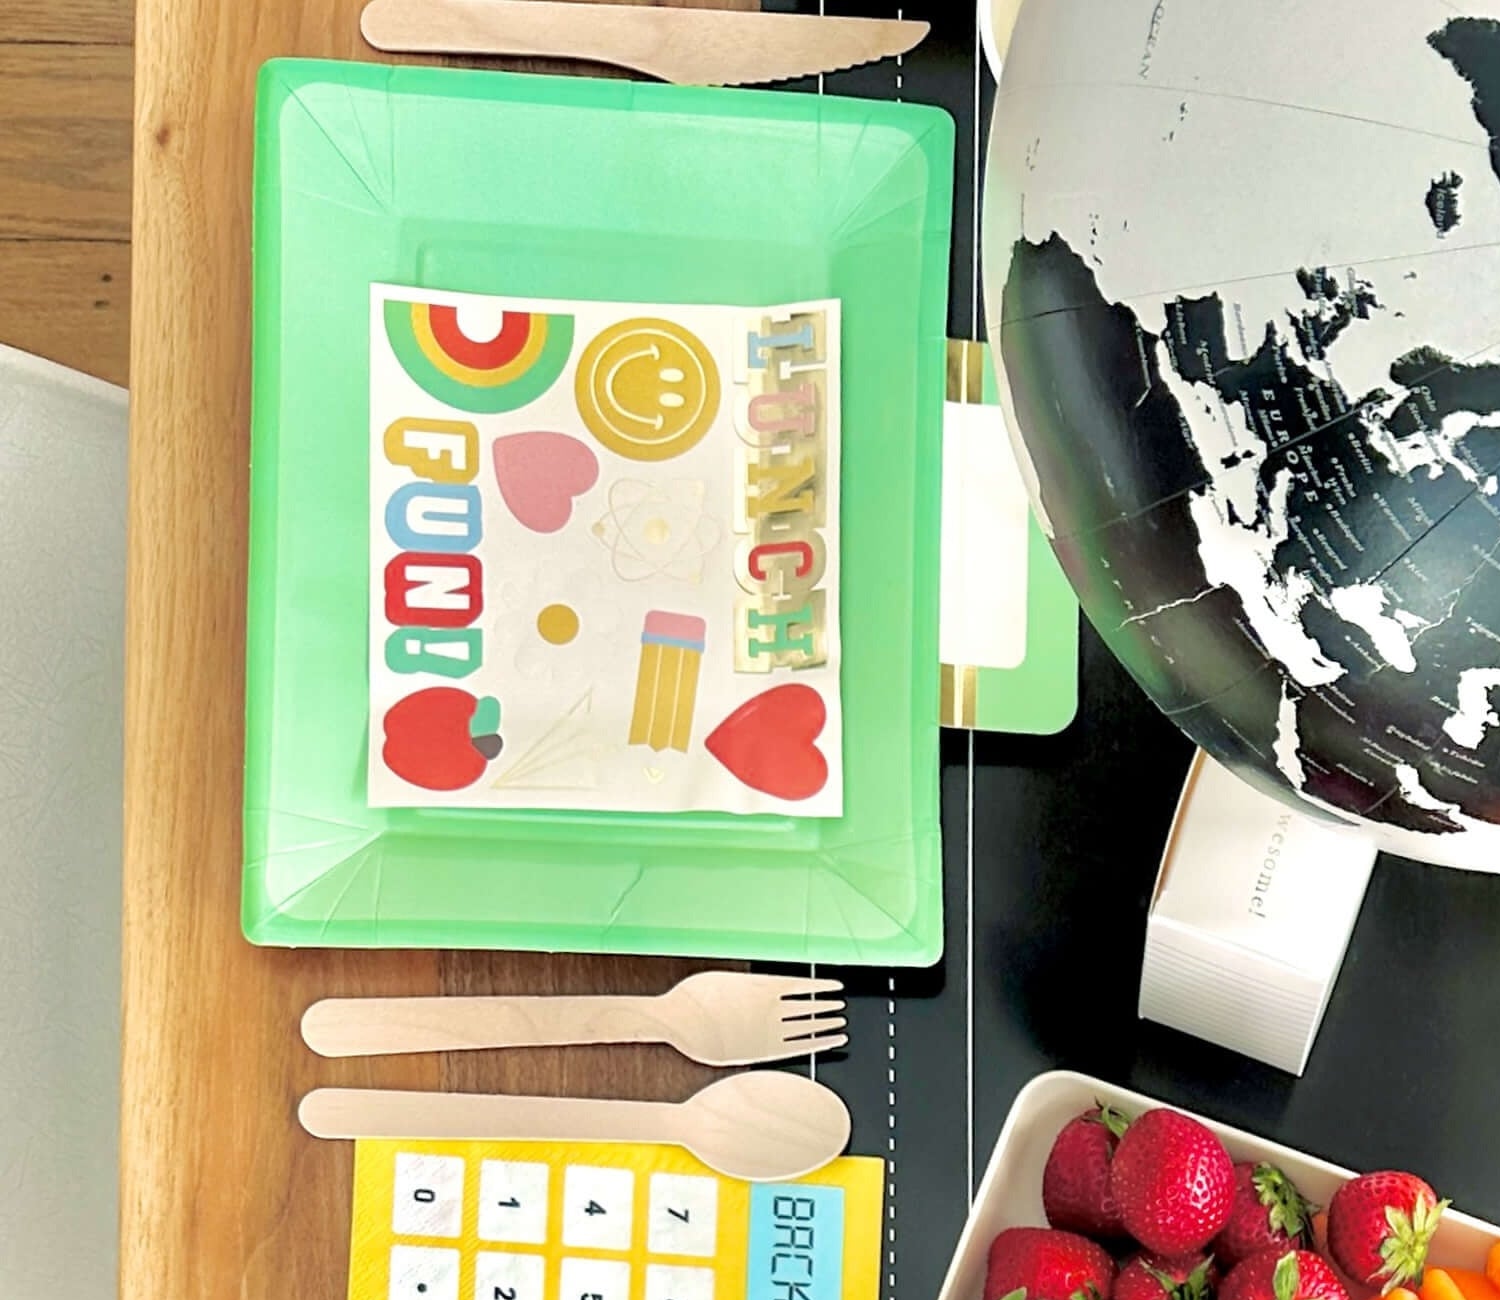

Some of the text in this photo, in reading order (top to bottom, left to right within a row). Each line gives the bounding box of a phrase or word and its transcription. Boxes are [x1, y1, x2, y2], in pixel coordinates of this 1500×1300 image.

[1418, 384, 1439, 413] Oslo
[1262, 388, 1320, 503] EUROPE
[1350, 438, 1375, 475] Berlin
[736, 311, 825, 674] LUNCH
[1328, 476, 1348, 506] Wien
[1334, 463, 1358, 499] Praha
[382, 415, 486, 680] FUN!
[1248, 813, 1292, 919] wesome!
[413, 1188, 435, 1203] 0
[498, 1197, 520, 1208] 1
[584, 1199, 607, 1216] 4
[667, 1207, 689, 1223] 7
